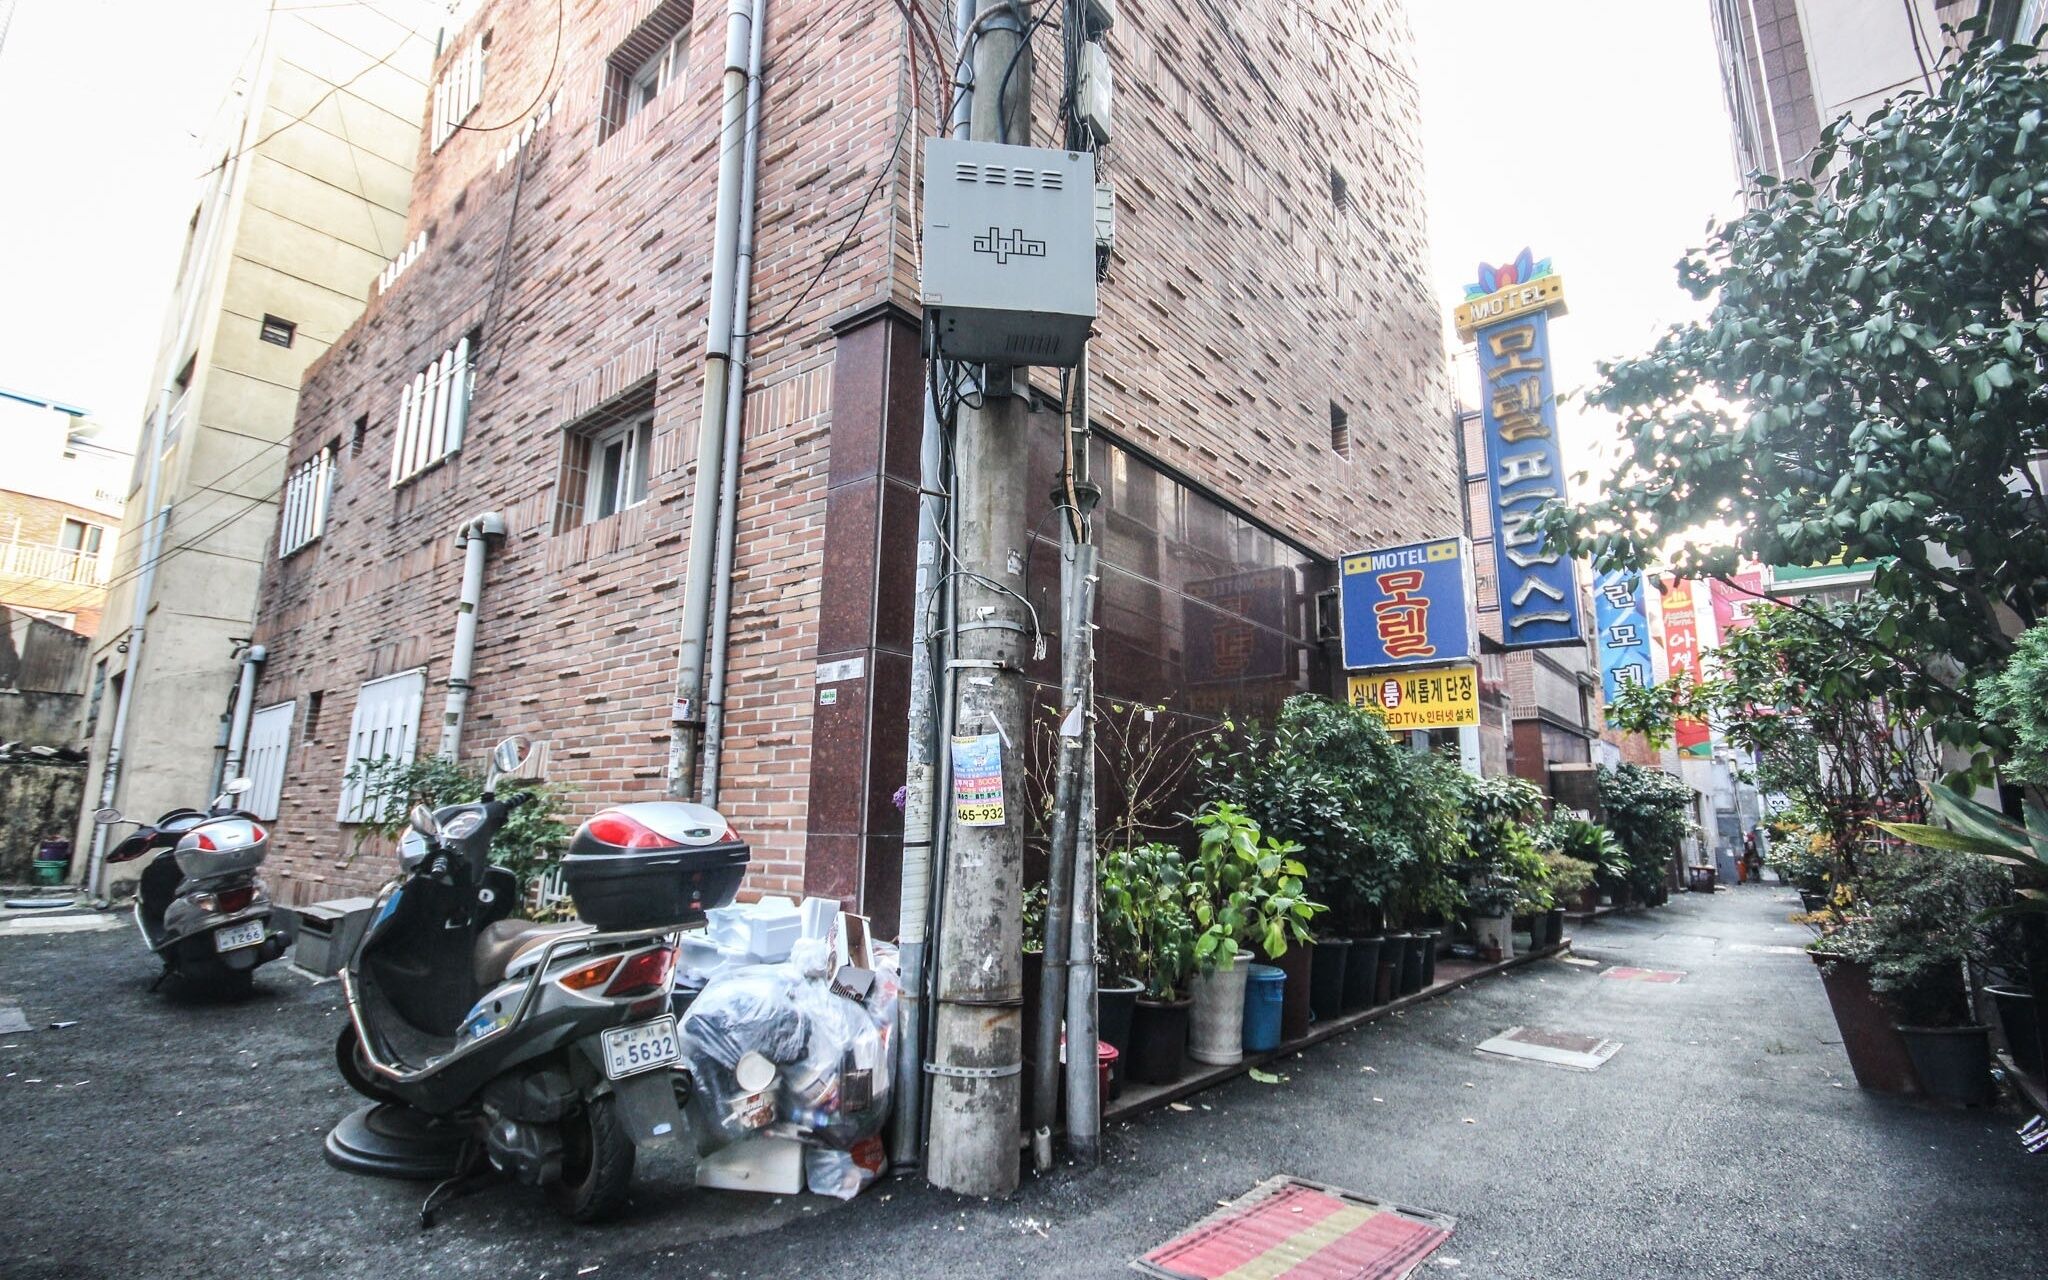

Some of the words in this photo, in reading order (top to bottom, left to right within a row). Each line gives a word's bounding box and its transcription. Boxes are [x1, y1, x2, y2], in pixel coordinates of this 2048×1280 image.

[973, 227, 1046, 264] alpha
[1470, 285, 1545, 322] MOTEL
[1487, 324, 1552, 441] 모텔
[1372, 548, 1427, 571] MOTEL
[1373, 569, 1437, 660] 모텔
[1383, 680, 1400, 708] 룸
[1405, 677, 1443, 704] 새롭게
[1446, 674, 1472, 702] 단장
[231, 930, 260, 945] 1266
[628, 1036, 674, 1064] 5632
